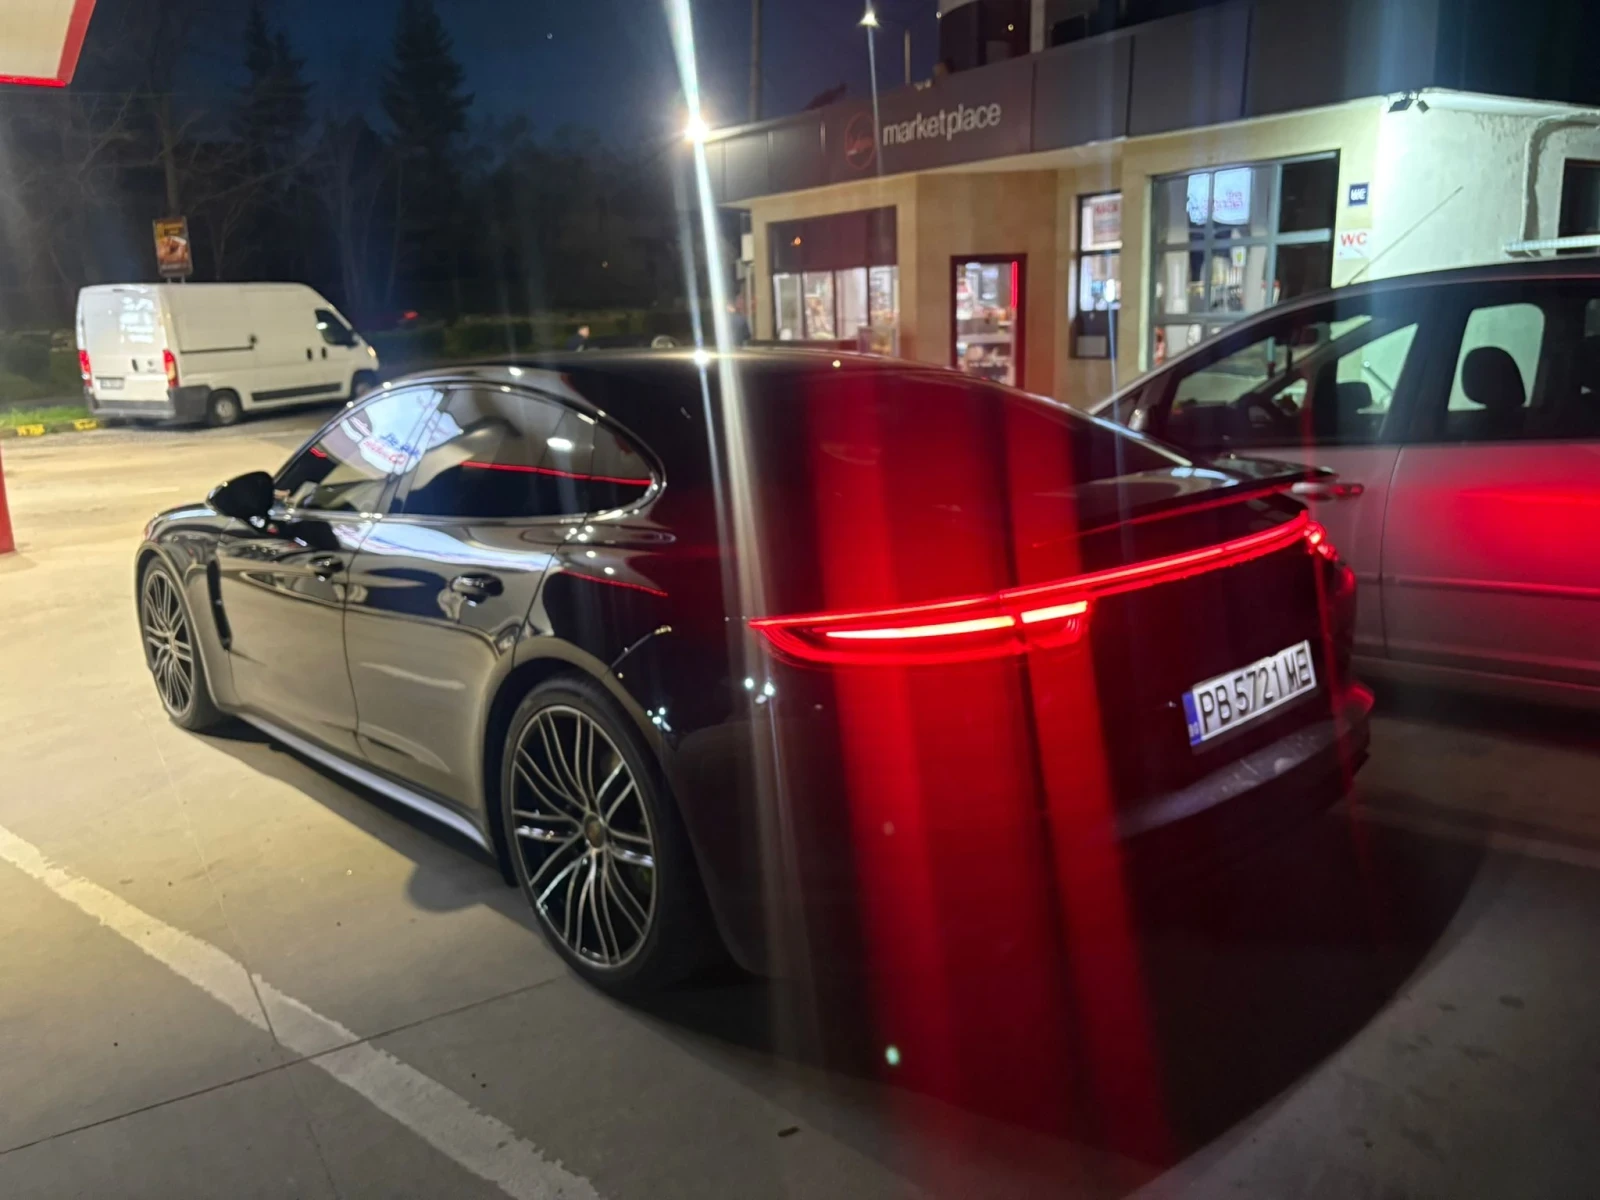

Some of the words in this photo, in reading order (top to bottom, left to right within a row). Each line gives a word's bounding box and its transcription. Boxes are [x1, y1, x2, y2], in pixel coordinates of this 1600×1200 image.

[882, 103, 1002, 147] marketplace
[1340, 231, 1368, 247] WC
[1198, 684, 1232, 734] PB
[1234, 660, 1283, 717] 5721
